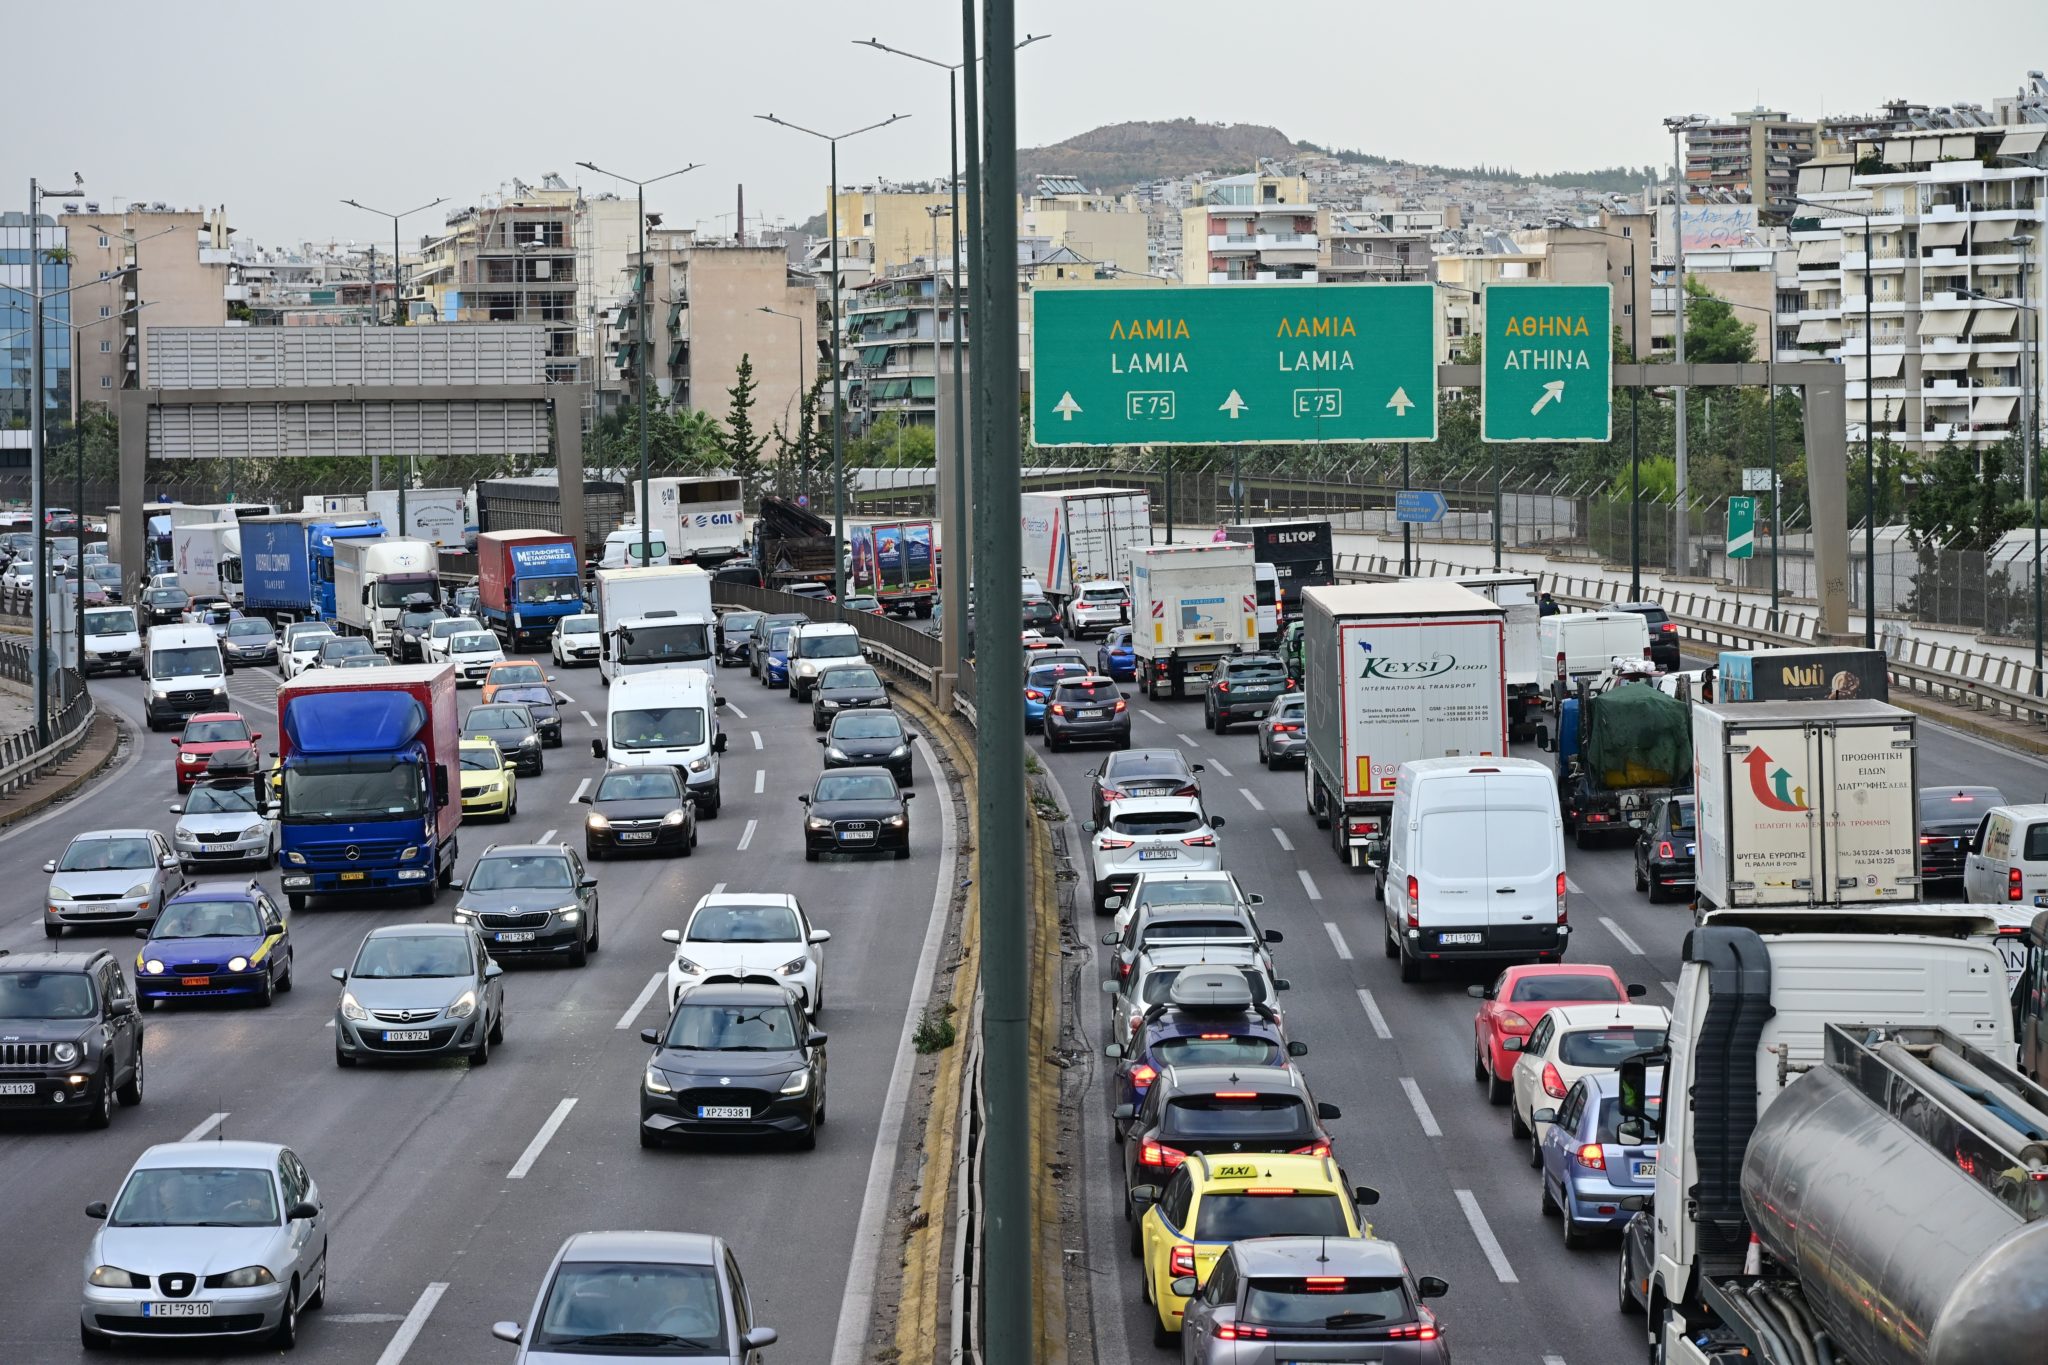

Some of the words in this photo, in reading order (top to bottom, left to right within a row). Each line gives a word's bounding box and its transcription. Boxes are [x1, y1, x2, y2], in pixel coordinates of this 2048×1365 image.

[1110, 319, 1190, 339] ΛΑΜΙΑ
[1277, 317, 1356, 337] ΛΑΜΙΑ
[1505, 316, 1589, 336] ΑΘΗΝΑ
[1112, 353, 1188, 373] LAMIA
[1279, 350, 1354, 371] LAMIA
[1504, 349, 1590, 370] ATHINA
[1278, 531, 1316, 544] ELTOP
[1359, 657, 1439, 679] KEYSI
[1841, 752, 1903, 762] ΠΡΟΩΘΗΤΙΚΗ
[1858, 767, 1886, 775] ΕΙΔΩΝ
[1624, 796, 1635, 809] A
[1796, 821, 1809, 829] ΚΑΙ
[1850, 819, 1891, 827] ΤΡΟΦΙΜΩΝ
[1736, 852, 1766, 860] ΨΥΓΕΙΑ
[1769, 851, 1806, 859] ΕΥΡΩΠΗΣ
[1445, 934, 1480, 942] ZTI-1071
[390, 1031, 428, 1041] IOX-8724
[0, 1083, 34, 1094] X-1123
[706, 1107, 749, 1118] XPZ-9381
[1220, 1166, 1249, 1175] TAXI
[155, 1304, 209, 1315] IEI-7910
